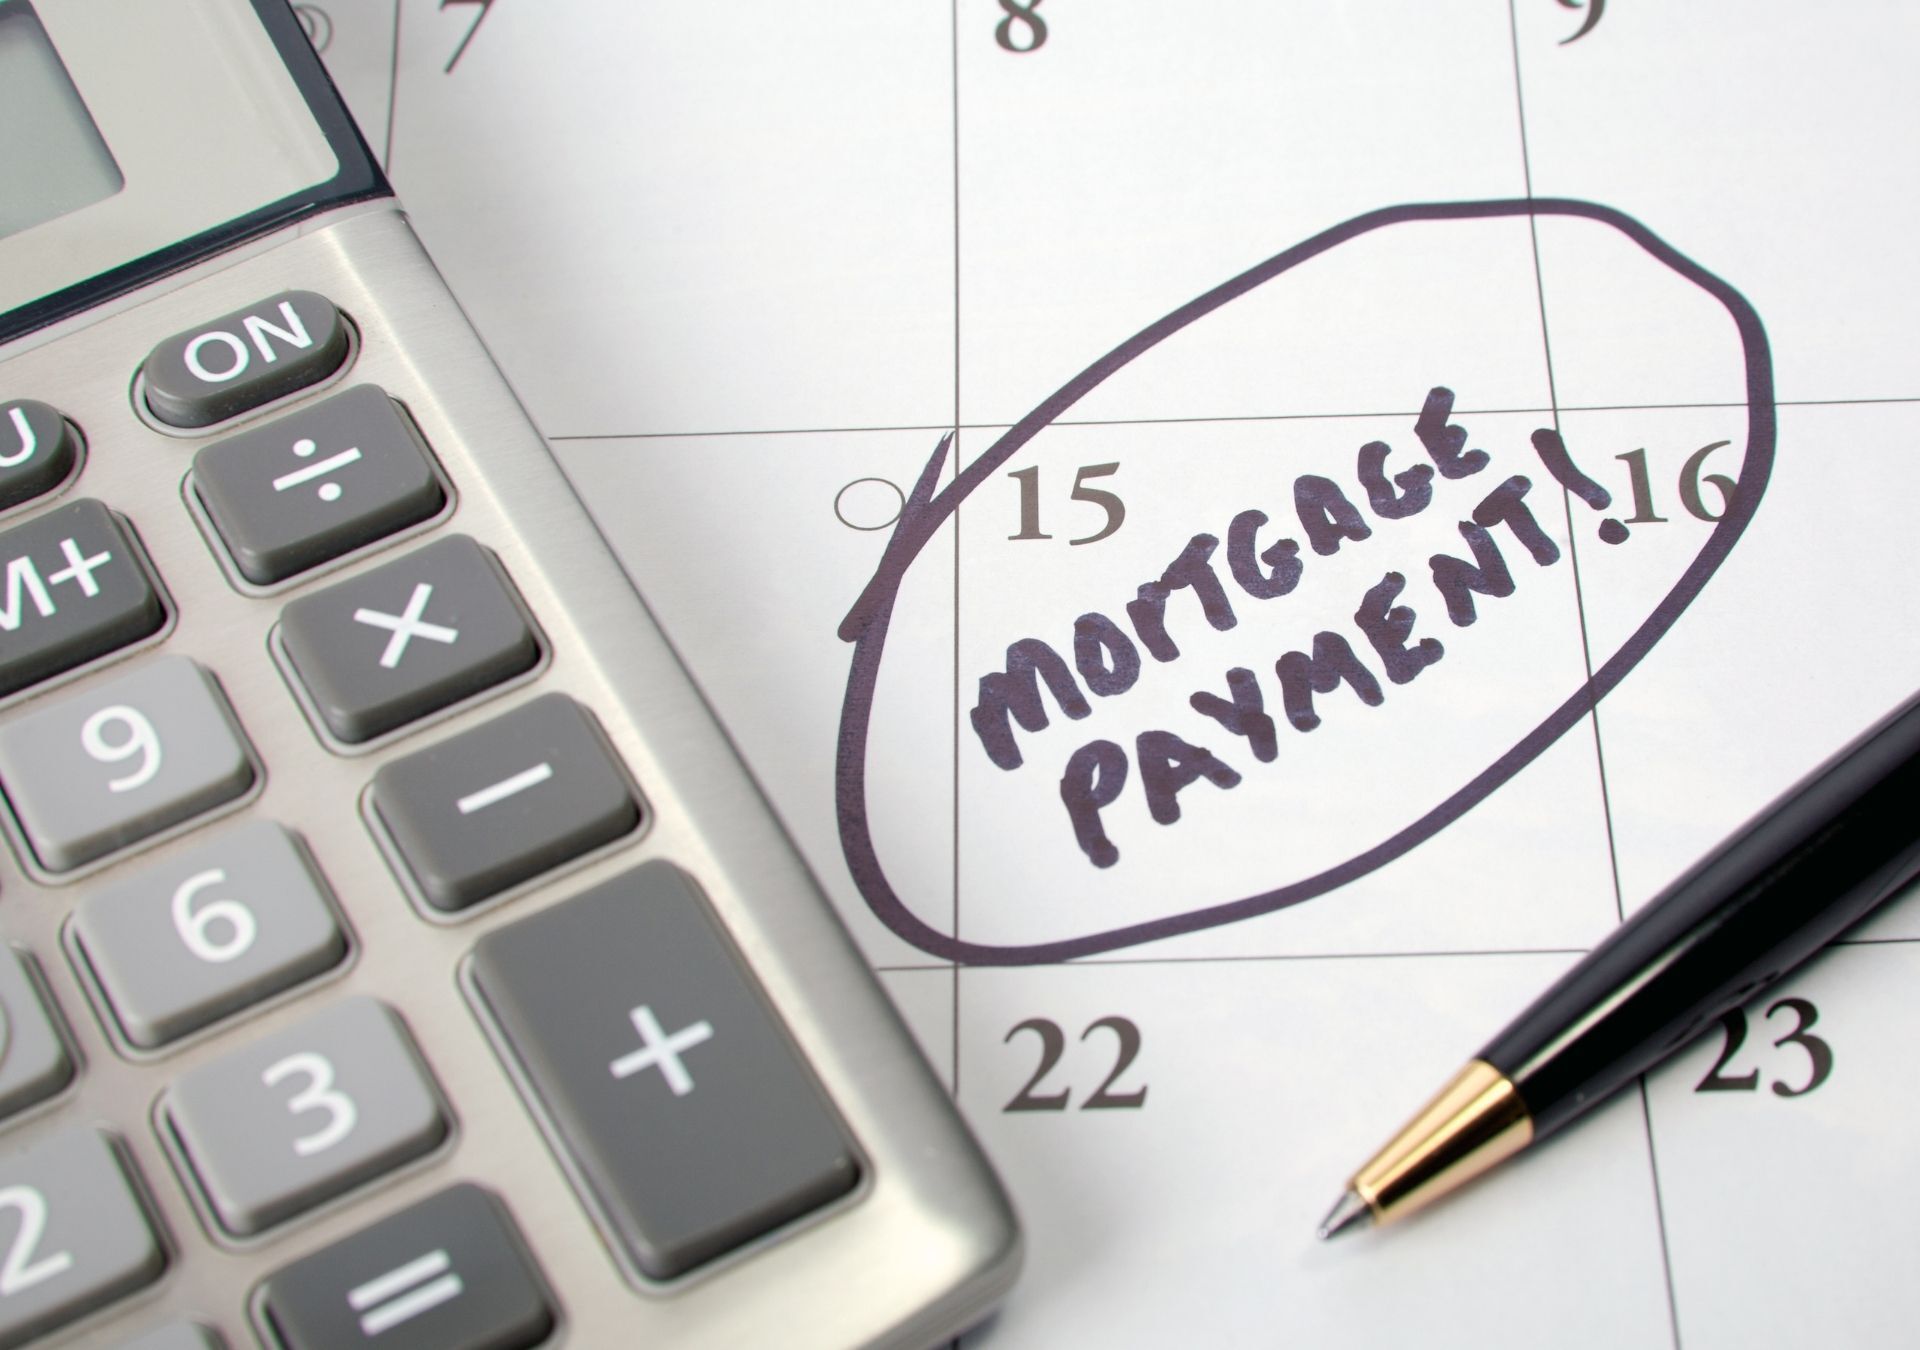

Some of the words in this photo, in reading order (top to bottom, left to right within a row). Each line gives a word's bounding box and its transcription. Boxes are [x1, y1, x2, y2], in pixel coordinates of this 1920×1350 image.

[439, 0, 495, 75] 7
[994, 0, 1048, 53] 8
[184, 300, 313, 383] ON
[1007, 461, 1127, 547] 15
[1614, 438, 1740, 524] 16
[1060, 427, 1631, 870] PAYMENT!
[80, 704, 162, 793] 9
[171, 868, 257, 963] 6
[1002, 1015, 1149, 1114] 22
[1694, 997, 1834, 1098] 23
[262, 1051, 358, 1157] 3
[0, 1185, 74, 1295] 2
